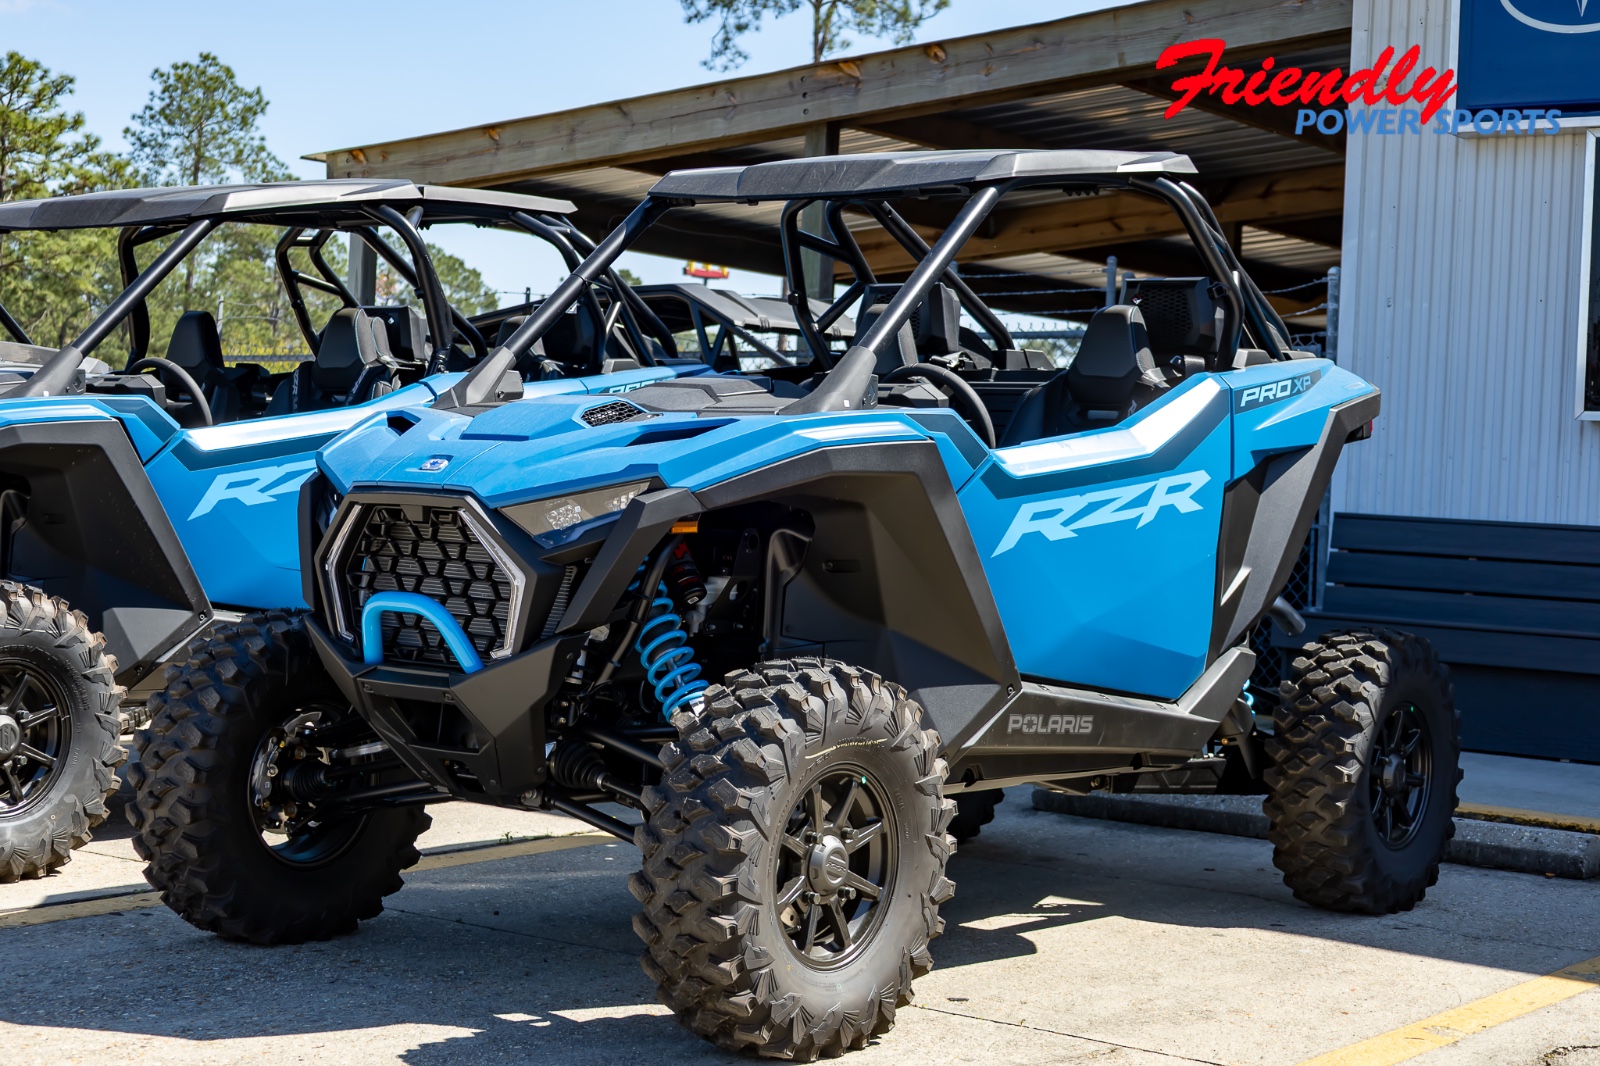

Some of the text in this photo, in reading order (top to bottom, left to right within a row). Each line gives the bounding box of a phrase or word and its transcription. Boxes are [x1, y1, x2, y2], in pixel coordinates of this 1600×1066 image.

[1240, 375, 1311, 407] PRO XP
[186, 459, 318, 521] RZ
[990, 470, 1211, 558] RZR
[1007, 714, 1094, 734] POLARIS
